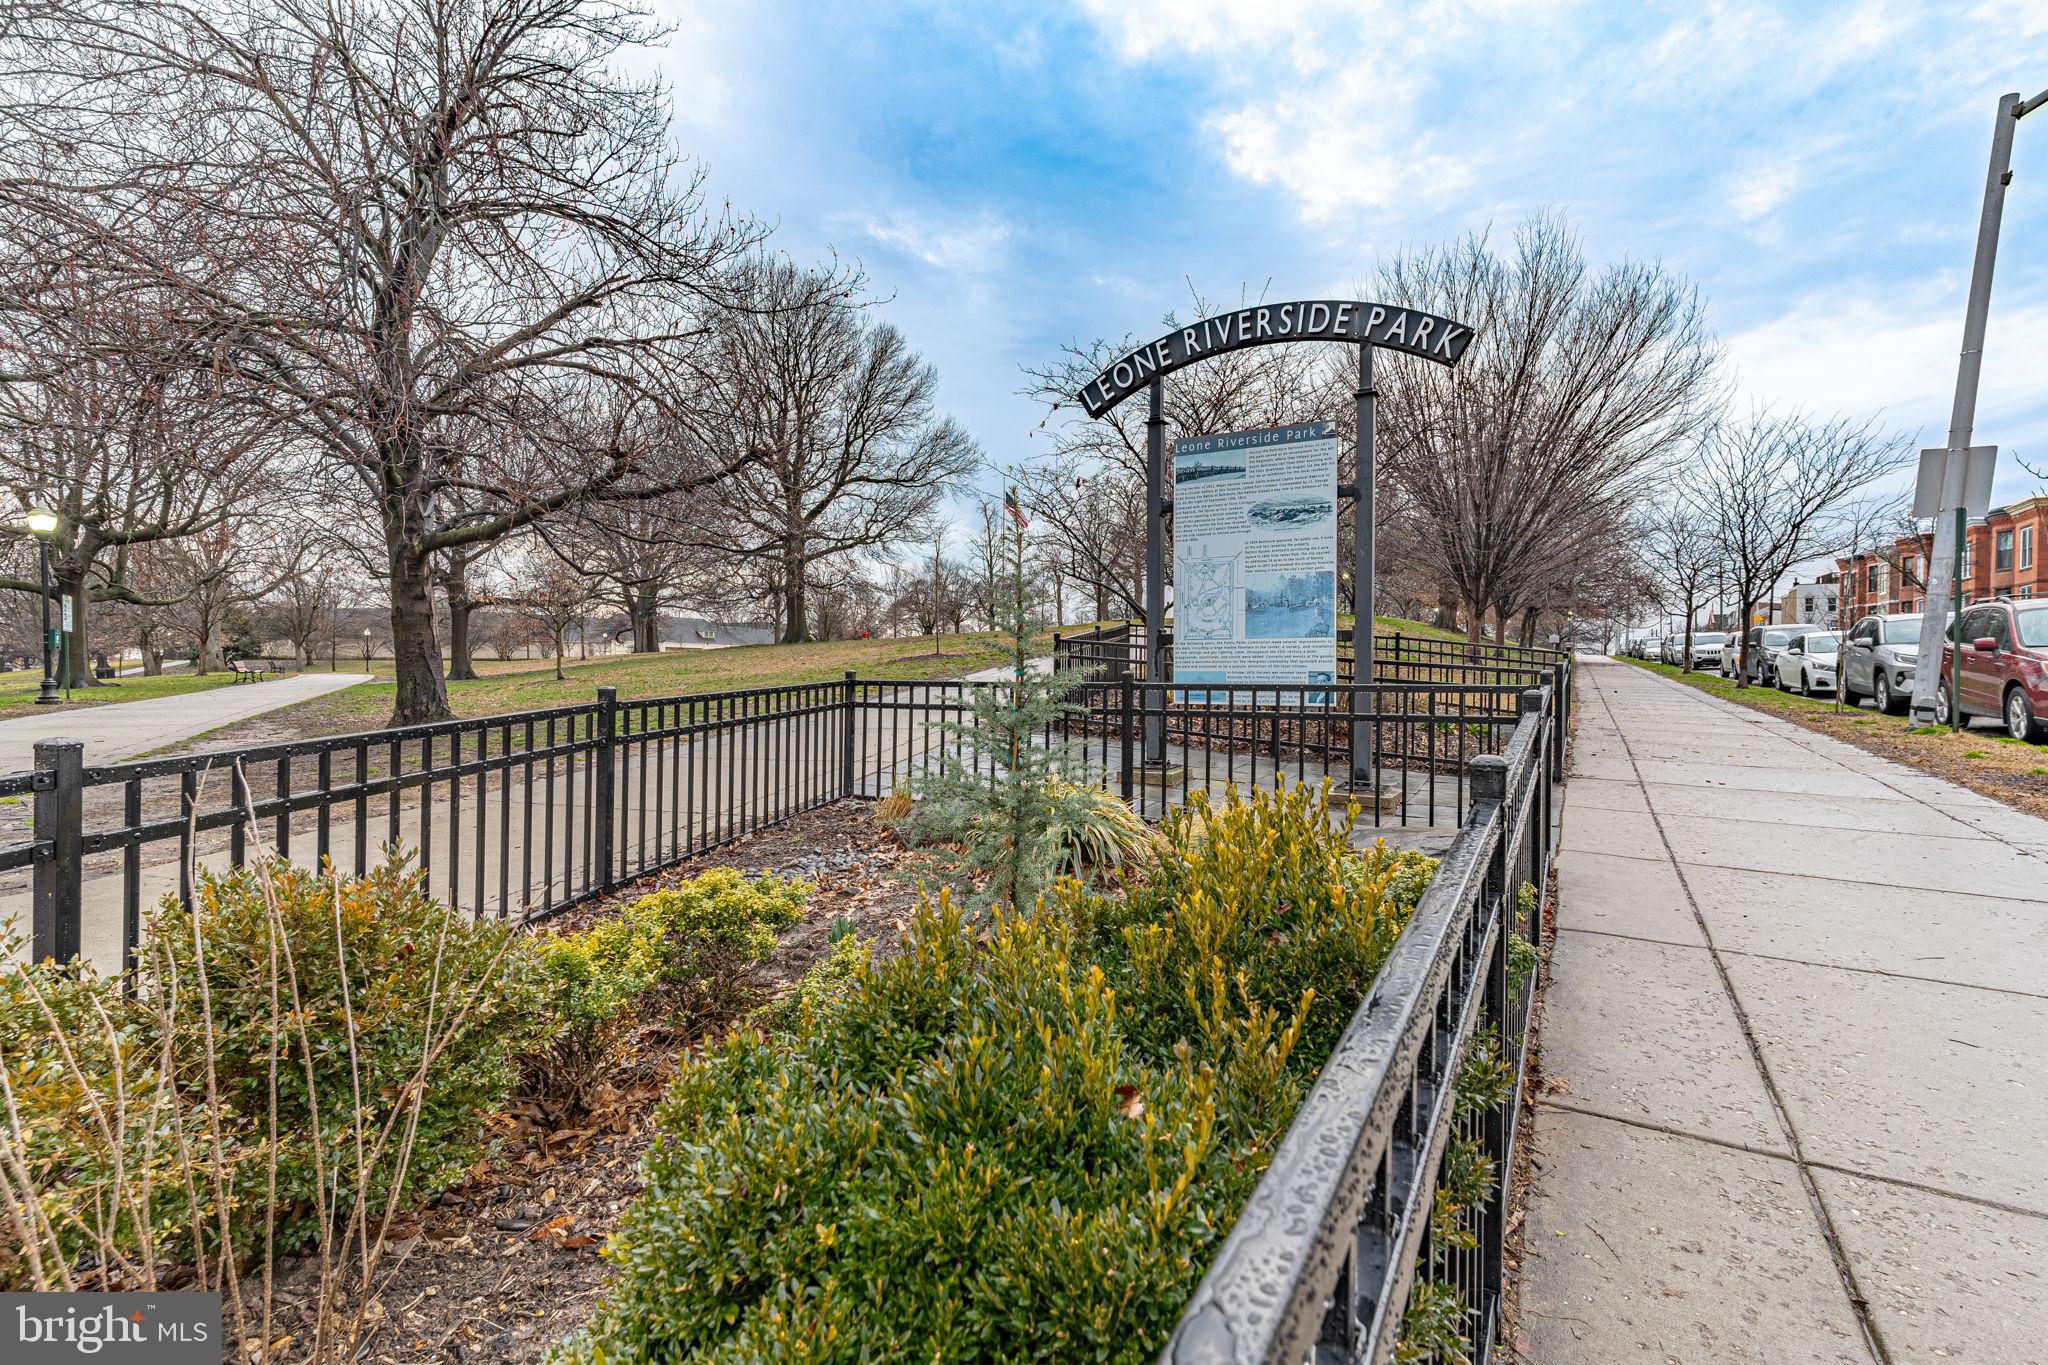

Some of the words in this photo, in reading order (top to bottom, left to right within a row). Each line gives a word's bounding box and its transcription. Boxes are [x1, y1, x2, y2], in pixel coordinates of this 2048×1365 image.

[1082, 338, 1173, 411] LEONE
[1183, 302, 1354, 355] RIVERSIDE
[1363, 306, 1466, 359] PARK
[1176, 442, 1211, 453] Leone
[1218, 432, 1279, 448] Riverside
[1286, 427, 1316, 441] Park
